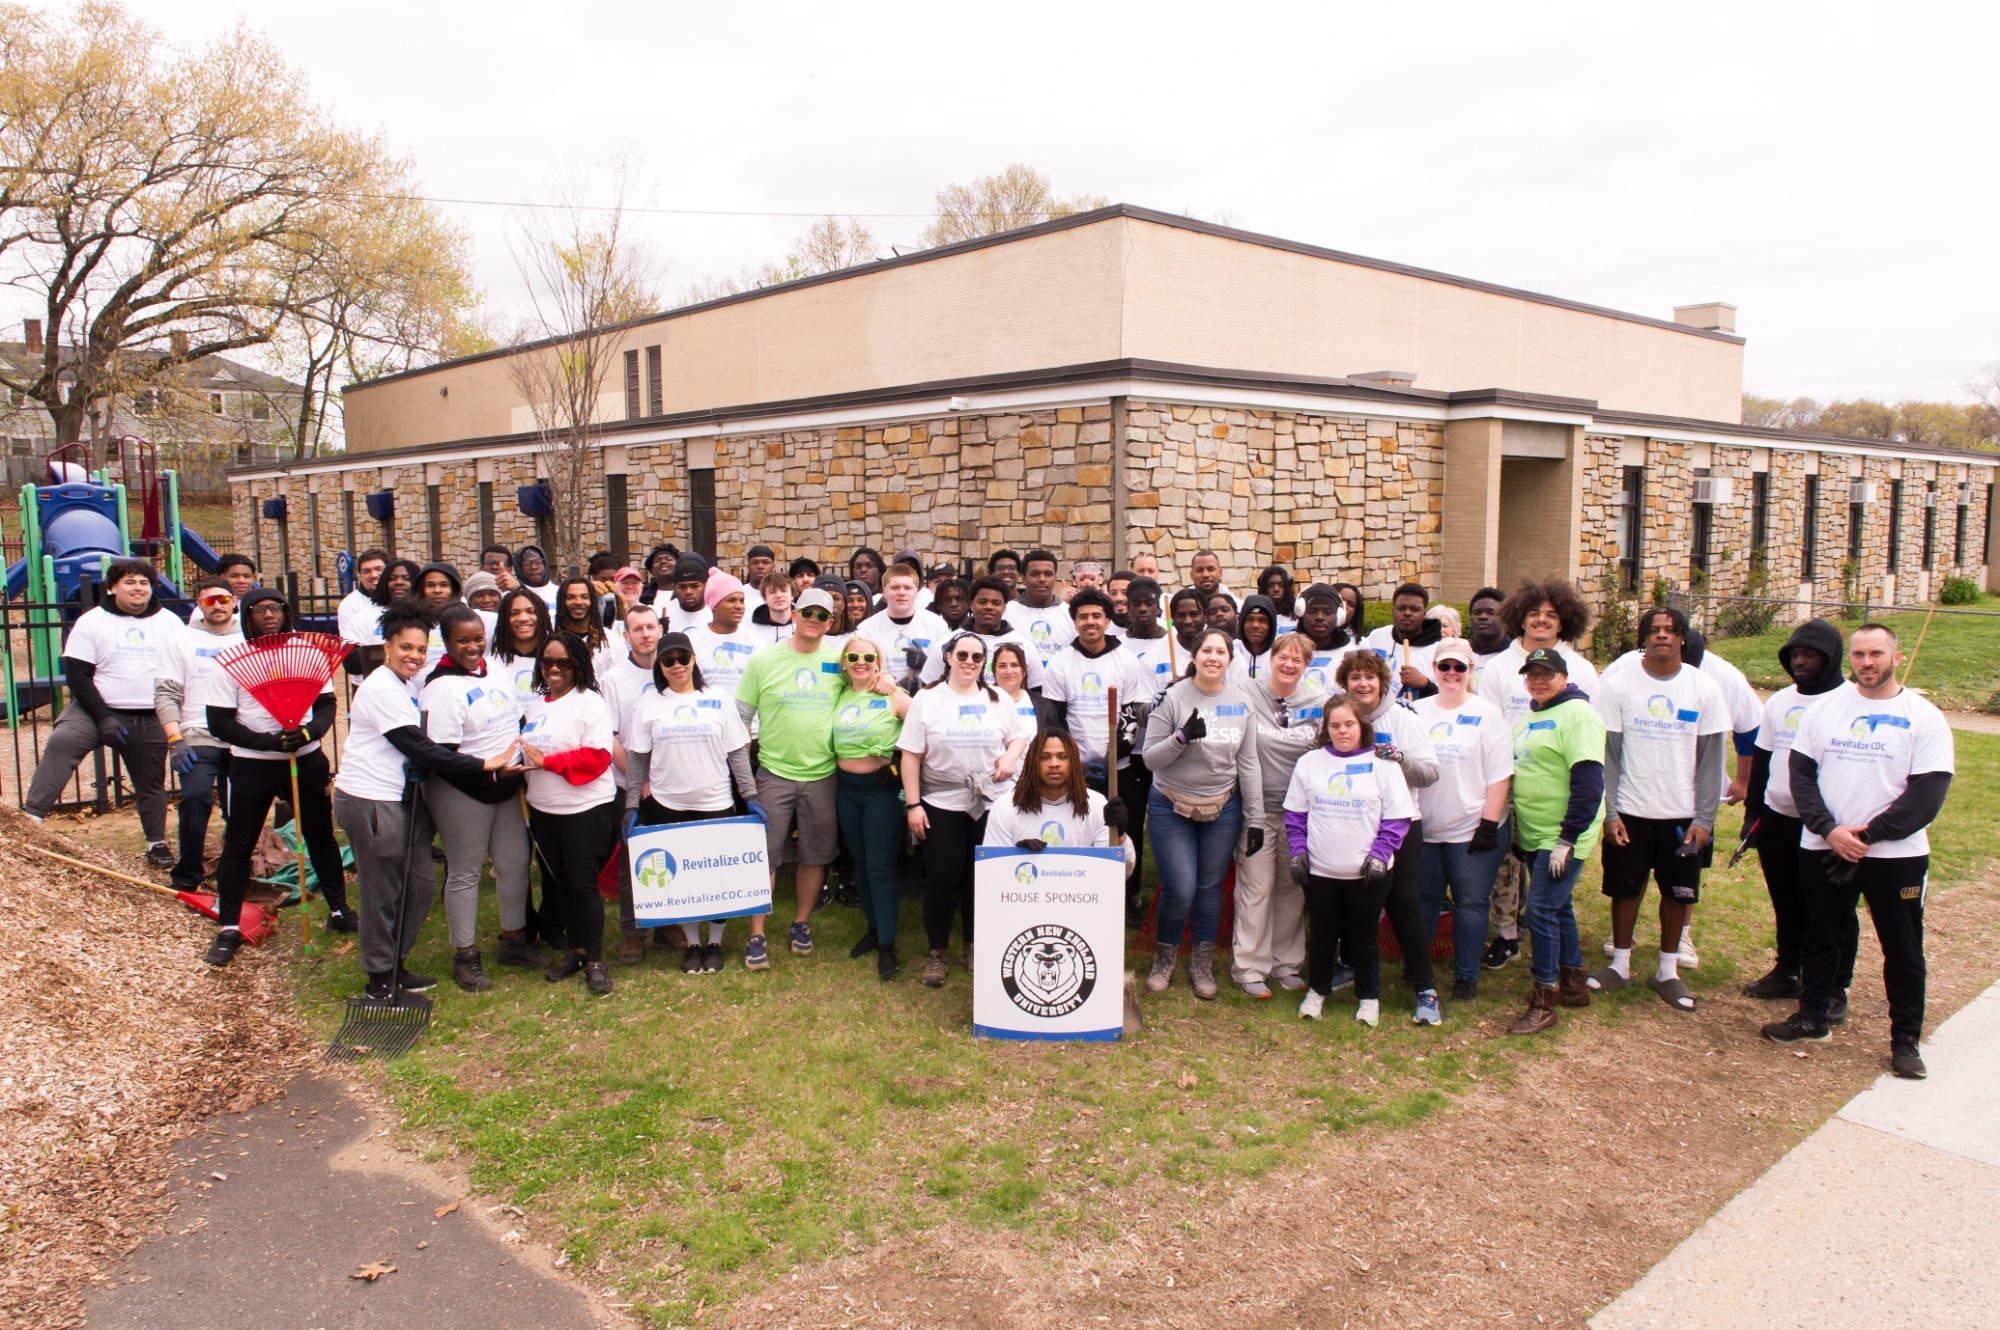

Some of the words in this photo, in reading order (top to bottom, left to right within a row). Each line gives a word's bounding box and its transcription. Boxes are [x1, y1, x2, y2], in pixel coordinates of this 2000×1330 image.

[1511, 696, 1530, 705] Revit
[661, 724, 698, 734] Revitalize
[1633, 717, 1673, 729] Revitalize
[1673, 721, 1687, 730] CDC
[946, 729, 983, 738] Revitalize
[1257, 722, 1316, 741] bankESB
[1830, 737, 1870, 750] Revitalize
[1870, 741, 1887, 752] CDC
[1314, 795, 1351, 808] Revitalize
[682, 855, 739, 871] Revitalize
[741, 851, 764, 864] CDC
[1040, 869, 1073, 877] Revitalize
[1073, 869, 1087, 877] CDC
[634, 888, 770, 910] www.RevitalizeCDC.com
[1001, 891, 1040, 903] HOUSE
[1045, 891, 1099, 904] SPONSOR
[1002, 929, 1035, 979] WESTERN
[1036, 925, 1064, 937] NEW
[1063, 930, 1096, 980] ENGLAND
[1013, 992, 1084, 1016] UNIVERSITY
